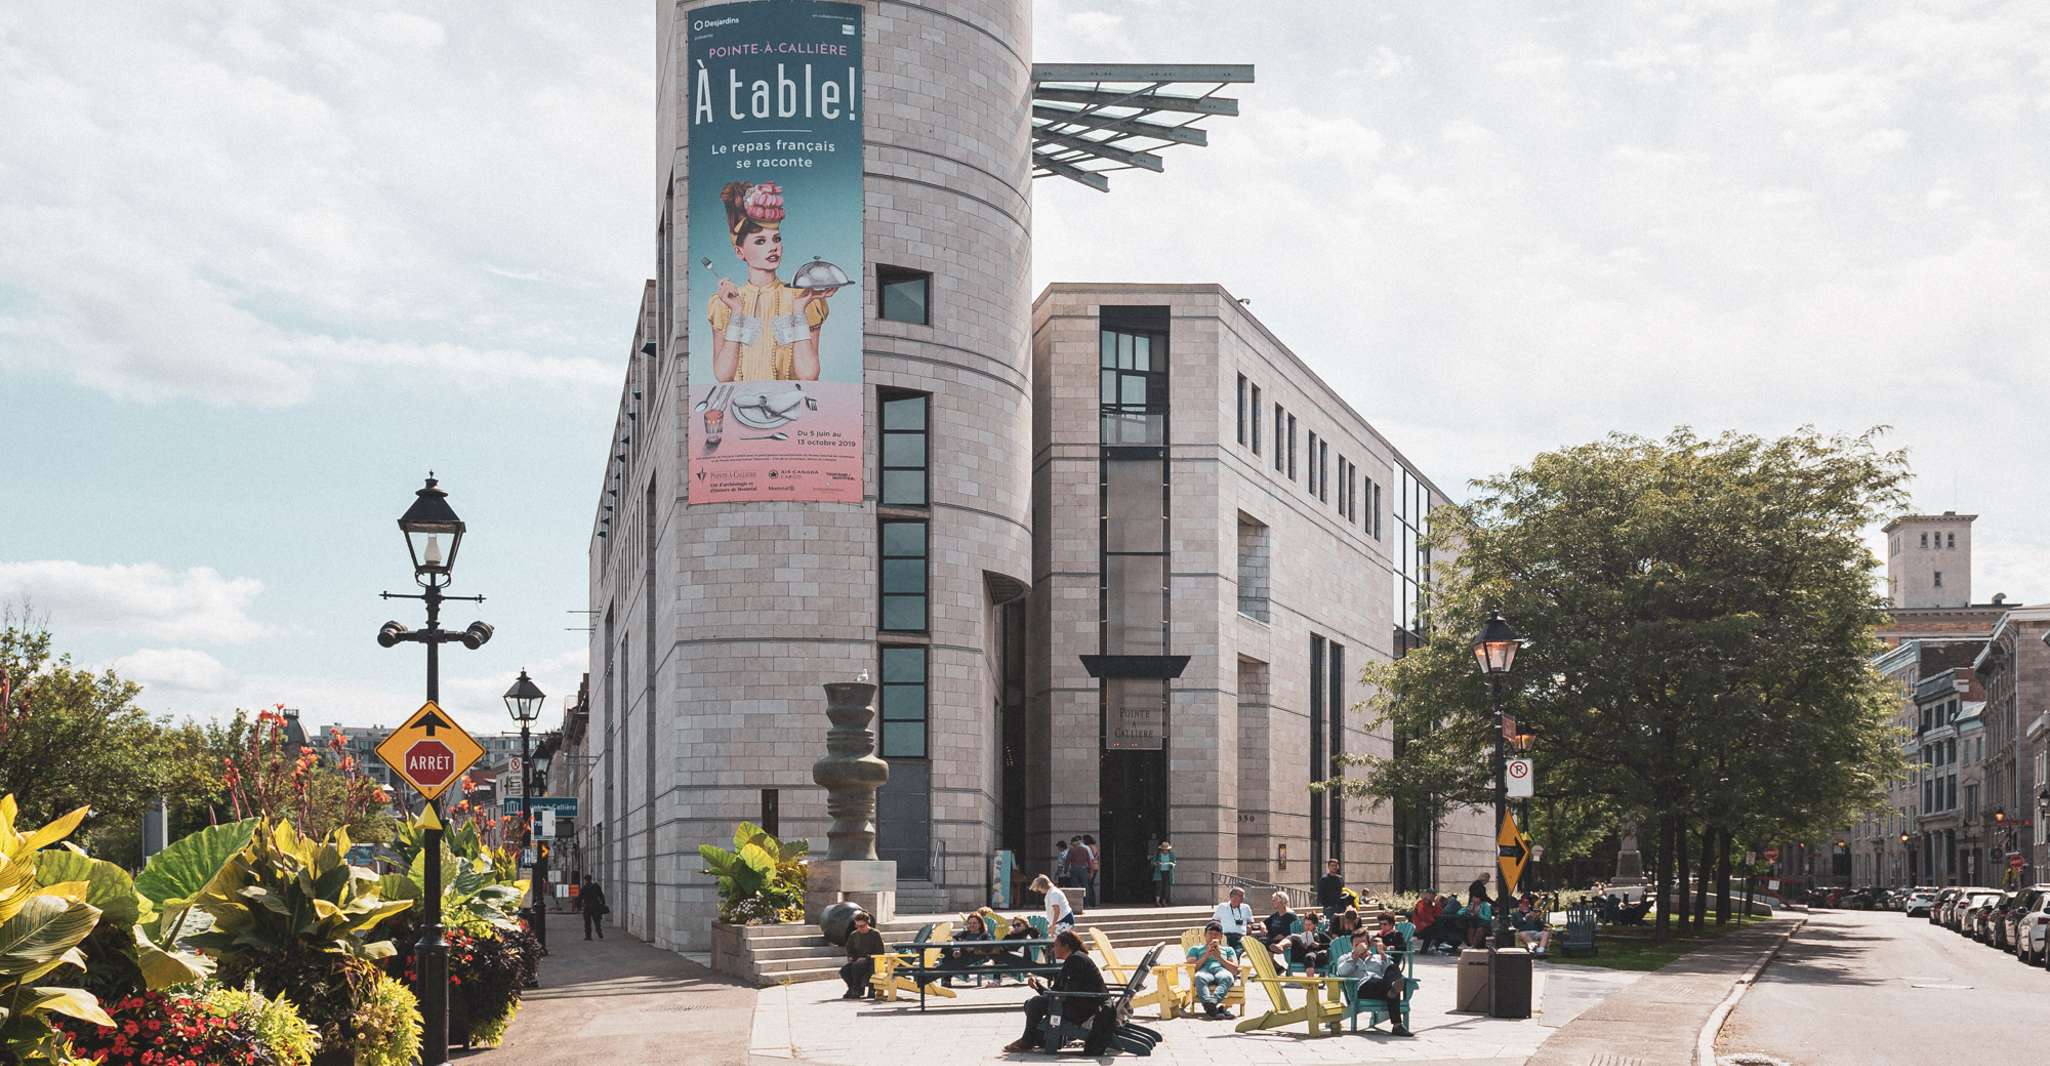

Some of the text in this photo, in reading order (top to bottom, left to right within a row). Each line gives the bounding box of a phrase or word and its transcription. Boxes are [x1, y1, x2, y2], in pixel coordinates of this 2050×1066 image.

[704, 17, 740, 28] Desjardins
[709, 42, 848, 58] POINTE-À-CALLIÈRE
[695, 59, 856, 125] À table!
[711, 139, 836, 156] Le repas français
[736, 157, 813, 168] se raconte
[816, 430, 831, 438] juin
[410, 754, 451, 770] ARRÊT
